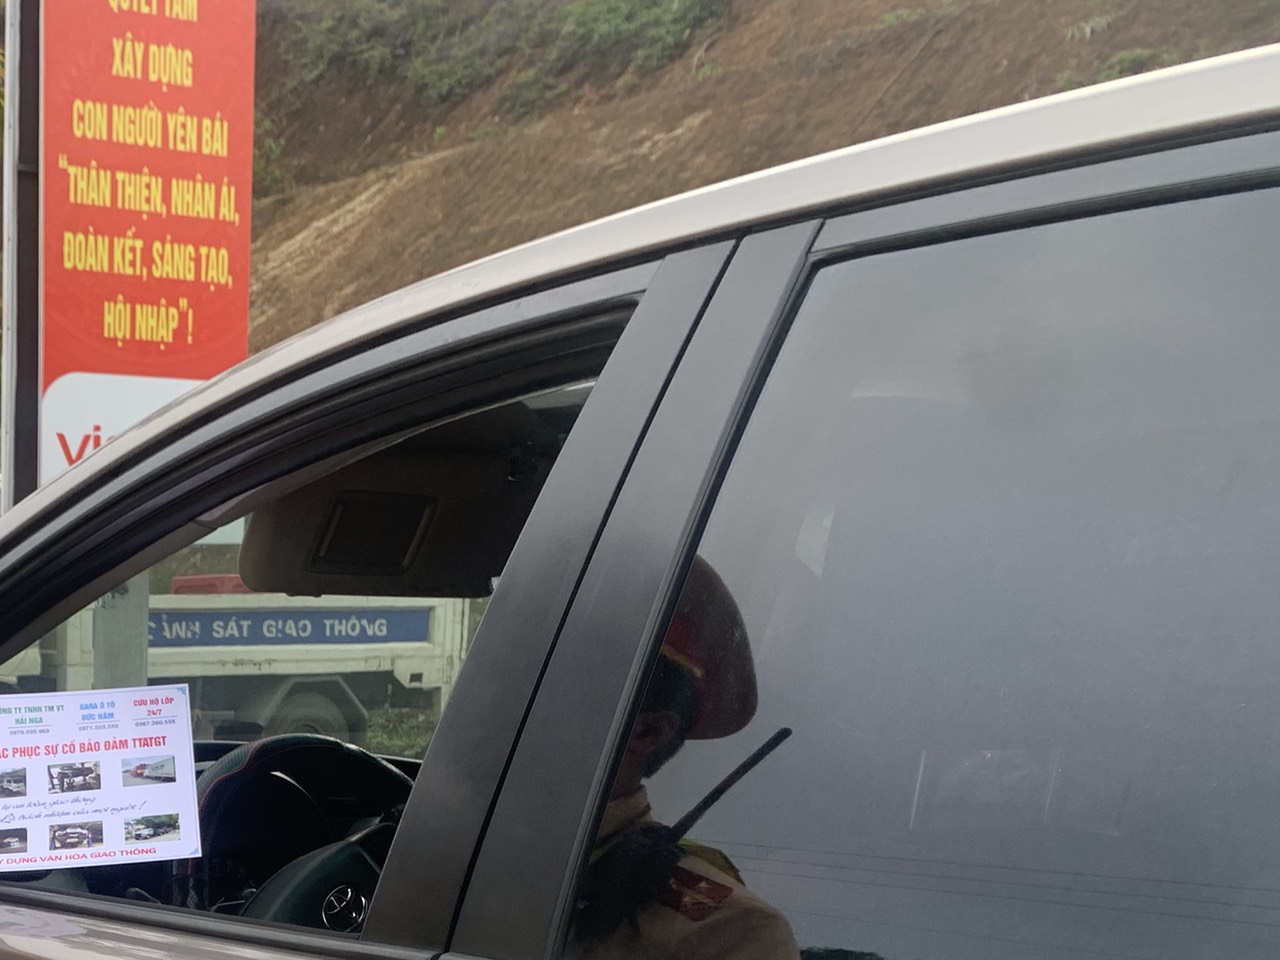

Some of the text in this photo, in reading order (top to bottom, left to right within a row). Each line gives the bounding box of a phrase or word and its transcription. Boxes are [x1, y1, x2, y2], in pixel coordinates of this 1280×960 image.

[112, 32, 193, 93] XÂY DỰNG
[73, 99, 228, 158] CON NGƯỜI YÊN BÁI
[116, 166, 167, 219] THIỆN,
[171, 175, 215, 218] NHÂN
[219, 178, 239, 226] ÁI,
[62, 225, 233, 291] ĐOÀN KẾT, SÁNG TẠO,
[103, 296, 130, 347] HỘI
[212, 616, 251, 638] SÁT
[262, 619, 312, 638] GIAO
[324, 615, 387, 637] THÔNG
[24, 706, 42, 714] TNHH
[28, 716, 43, 724] NGA
[12, 745, 40, 760] PHỤC
[44, 743, 59, 757] SỰ
[61, 739, 76, 755] CỐ
[79, 738, 100, 753] BẢO
[103, 736, 128, 751] ĐẢM
[131, 735, 167, 748] TTATGT
[6, 856, 37, 865] DỰNG
[90, 850, 117, 859] GIAO
[119, 847, 157, 856] THÔNG
